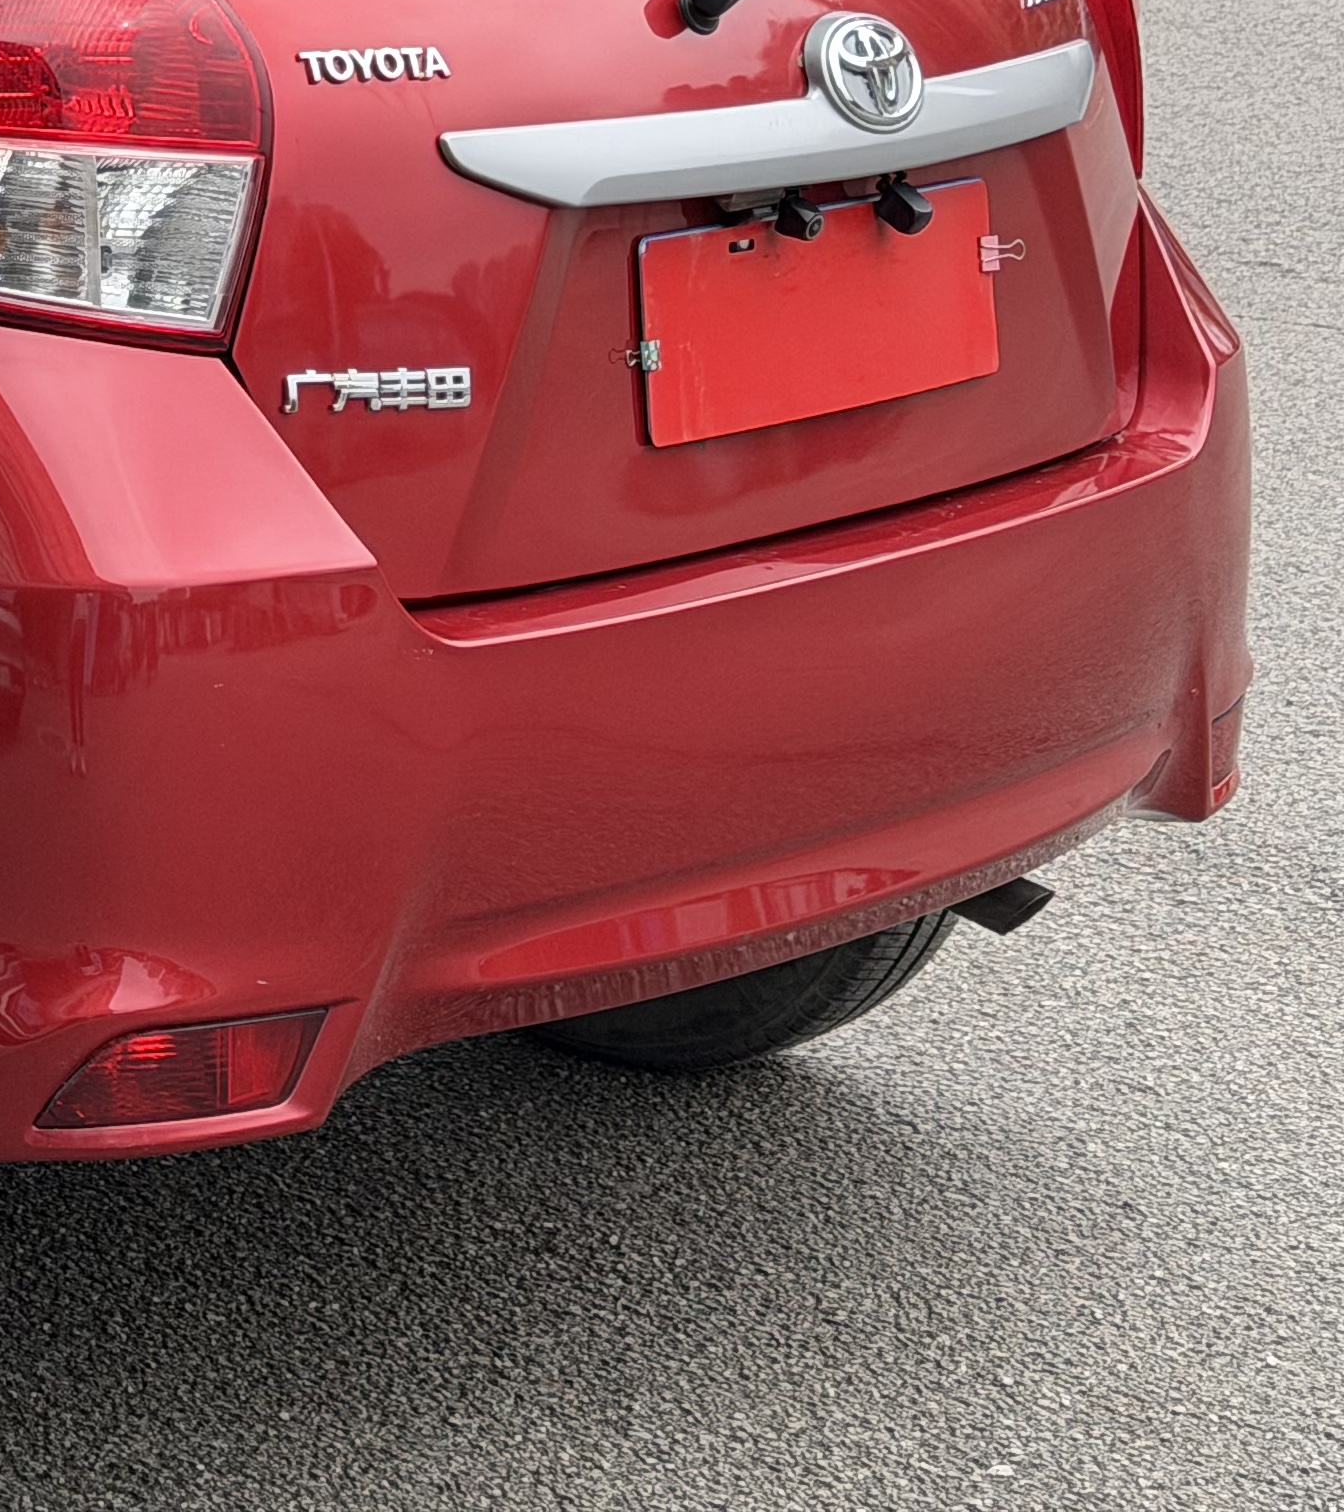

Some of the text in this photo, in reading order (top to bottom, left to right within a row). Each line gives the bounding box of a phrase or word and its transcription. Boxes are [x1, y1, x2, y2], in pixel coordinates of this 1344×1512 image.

[296, 46, 452, 86] TOYOTA
[281, 366, 472, 414] 广汽丰田
